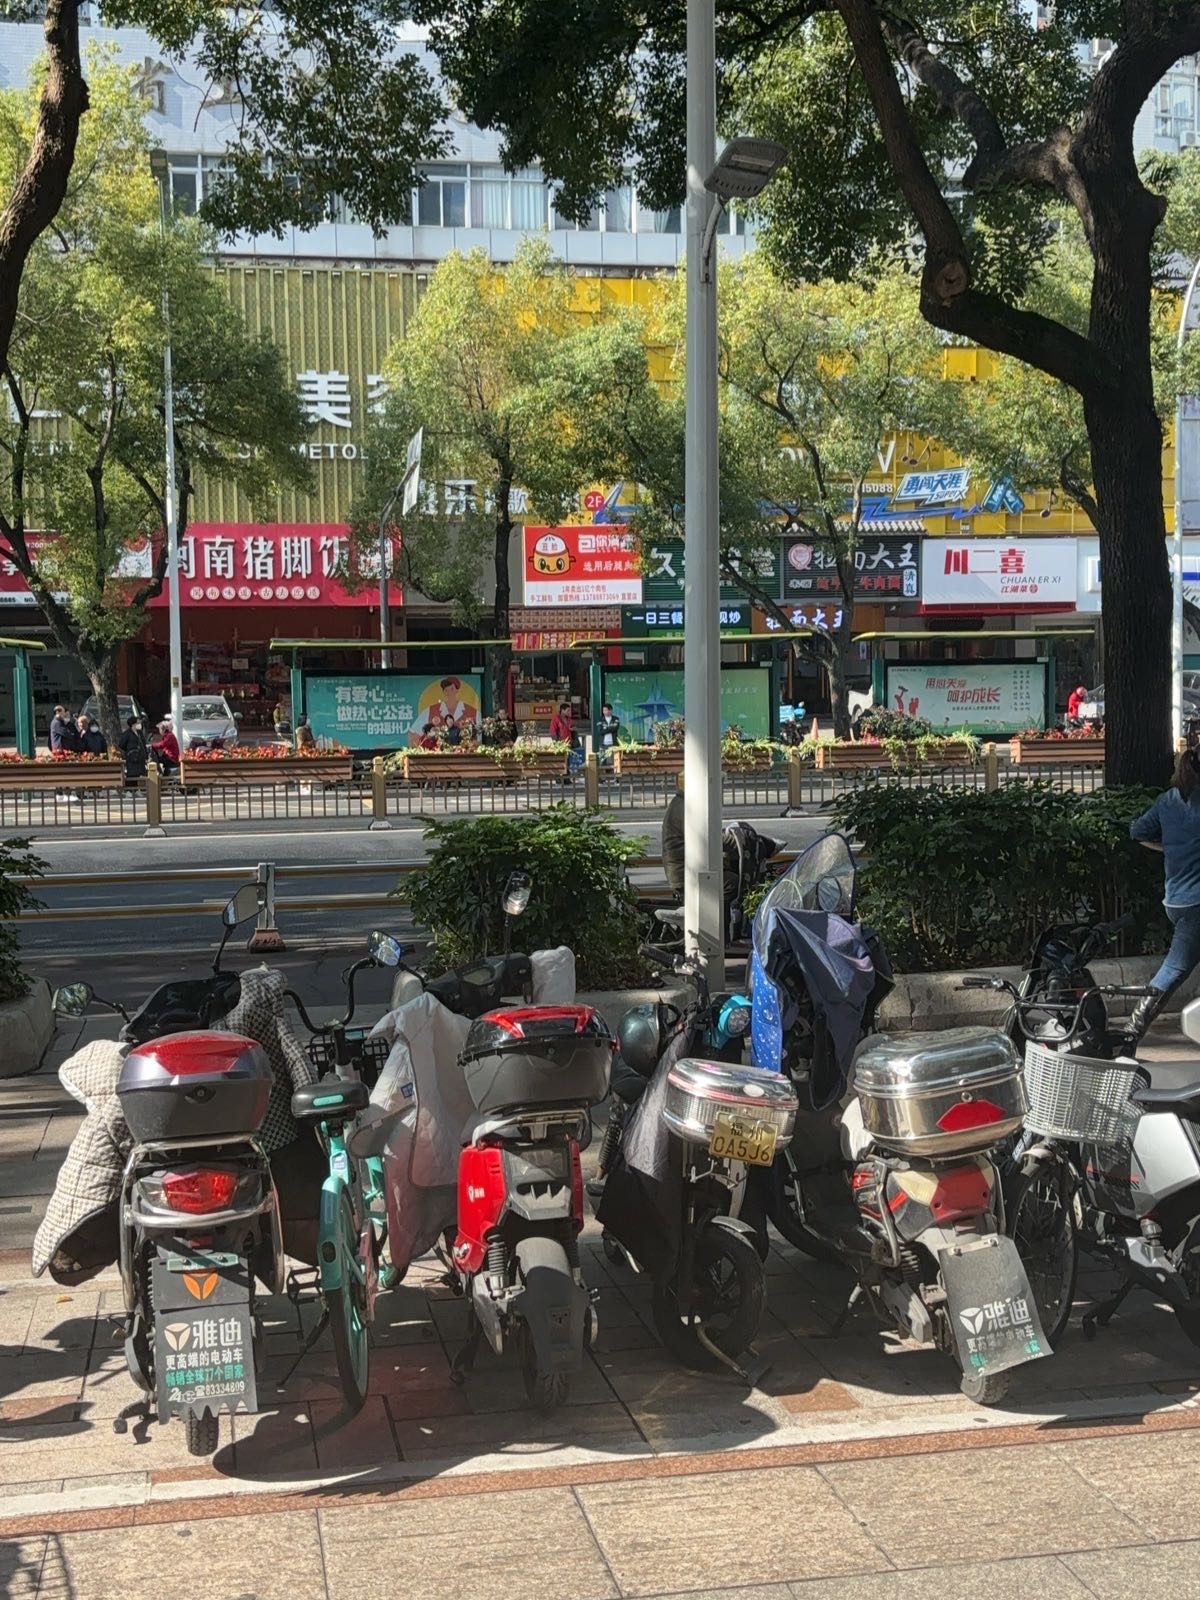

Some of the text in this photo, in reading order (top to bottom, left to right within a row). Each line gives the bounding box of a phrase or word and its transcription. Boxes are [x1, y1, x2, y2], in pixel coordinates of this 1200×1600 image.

[905, 472, 963, 492] 勇闯天涯
[587, 495, 602, 508] 2F
[944, 548, 1026, 575] 川二喜
[903, 571, 916, 594] 清真
[1000, 576, 1036, 584] CHUAN
[1000, 585, 1028, 593] 江湖菜
[335, 684, 385, 704] 有爱心
[947, 687, 1001, 704] 呵护成长
[337, 704, 414, 722] 做热心公益
[983, 1297, 1032, 1331] 雅迪
[192, 1318, 243, 1349] 雅迪
[165, 1349, 244, 1371] 更高端的电动车
